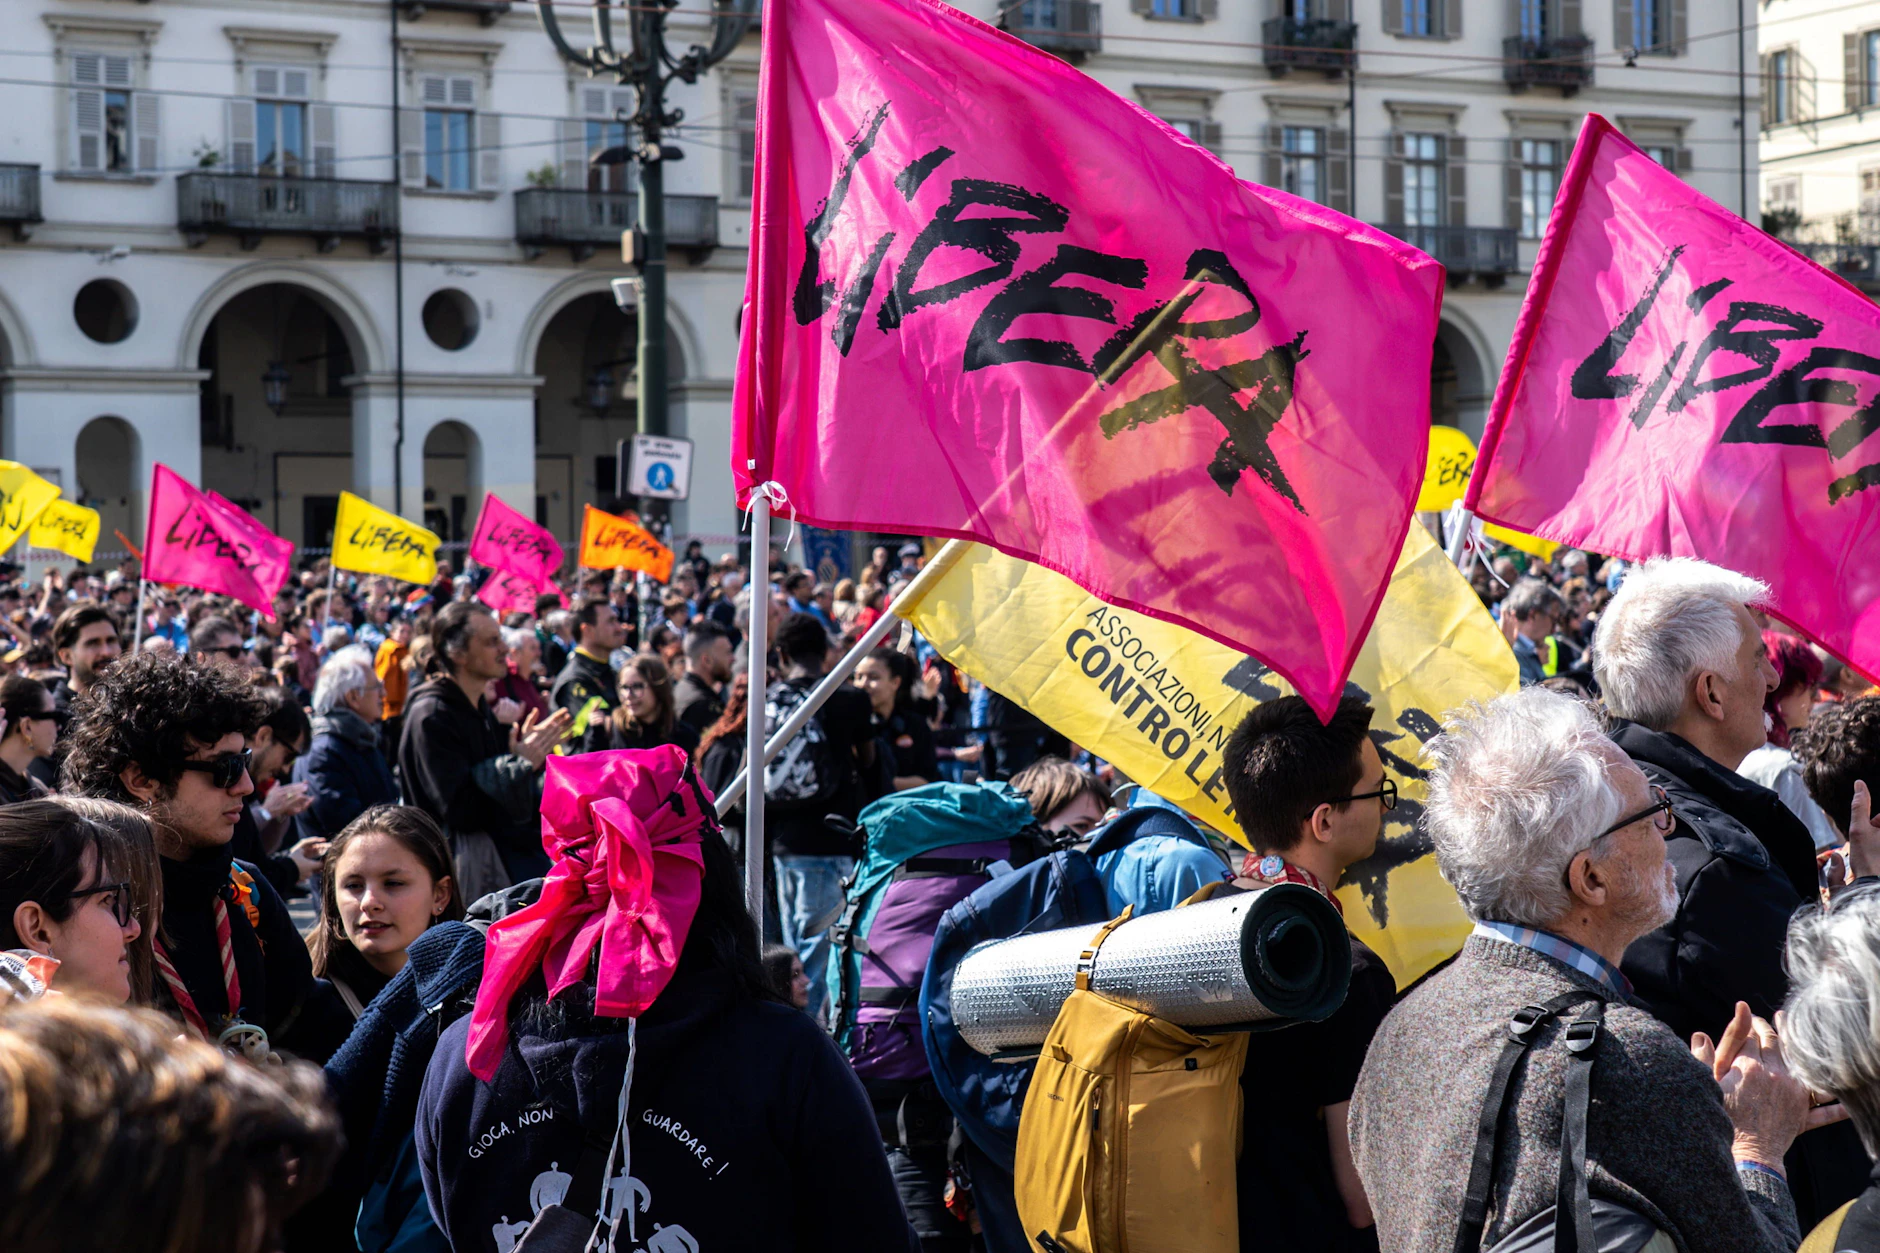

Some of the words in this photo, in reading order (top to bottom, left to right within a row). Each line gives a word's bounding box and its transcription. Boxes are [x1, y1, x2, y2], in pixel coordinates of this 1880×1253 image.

[1065, 627, 1190, 761] CONTRO
[1086, 605, 1212, 739] ASSOCIAZIONI,
[467, 1121, 515, 1159] GIOCA,
[518, 1106, 554, 1129] NON
[641, 1108, 714, 1169] GUARDARE
